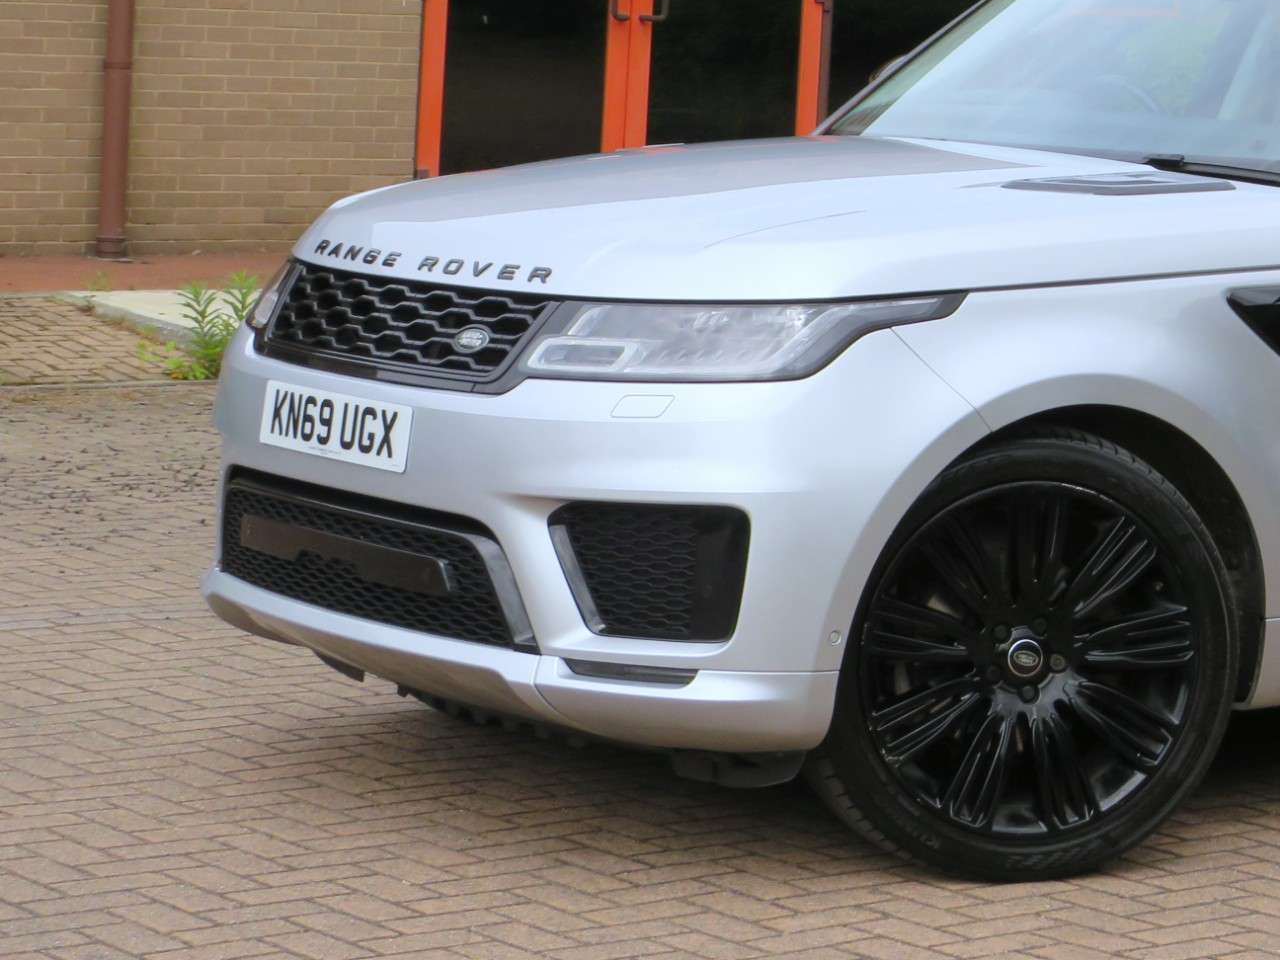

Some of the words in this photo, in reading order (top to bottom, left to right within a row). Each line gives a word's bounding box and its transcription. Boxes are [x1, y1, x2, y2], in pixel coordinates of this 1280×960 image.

[313, 239, 402, 268] RANGE
[417, 256, 553, 284] ROVER
[270, 389, 335, 446] KN69
[340, 402, 399, 459] UGX
